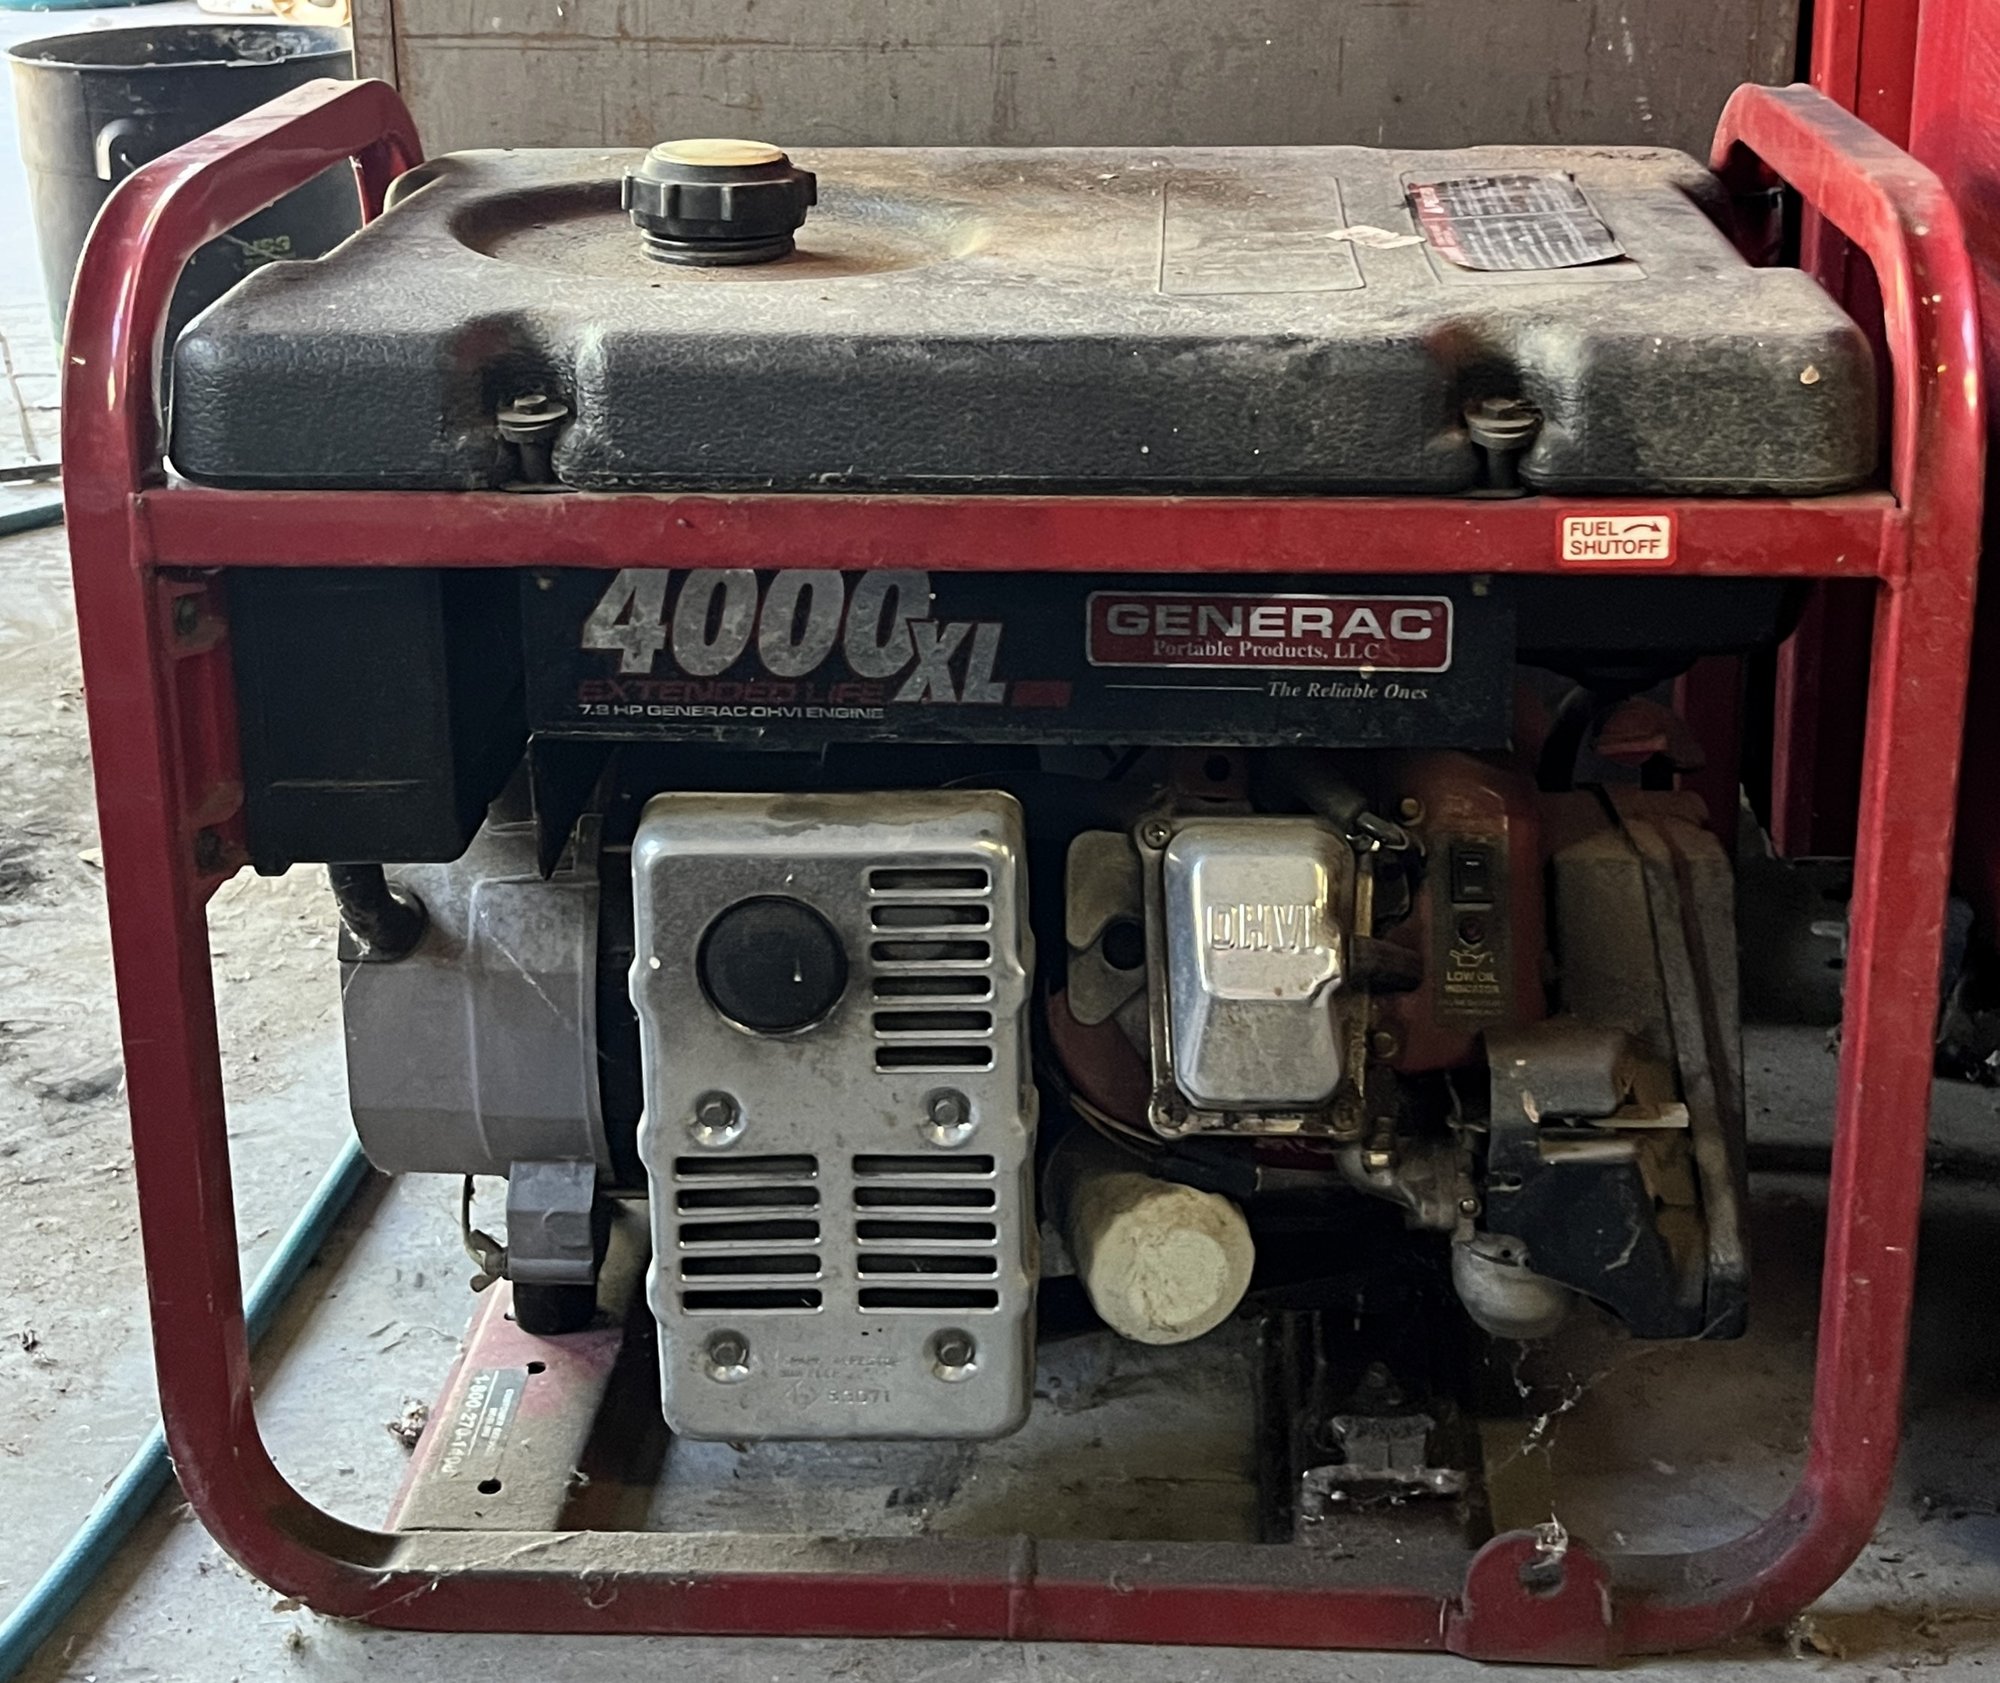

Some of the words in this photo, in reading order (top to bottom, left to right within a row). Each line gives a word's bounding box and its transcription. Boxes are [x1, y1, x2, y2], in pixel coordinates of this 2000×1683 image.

[1570, 521, 1619, 537] FUEL
[1570, 539, 1662, 555] SHUTOFF
[1106, 603, 1433, 641] GENERAC
[581, 568, 931, 678] 4000
[893, 618, 1008, 703] XL
[1153, 640, 1234, 657] Portable
[1239, 641, 1329, 660] Products,
[1334, 643, 1381, 660] LLC
[578, 680, 796, 702] EXTENDED
[1268, 681, 1301, 698] The
[1307, 682, 1379, 699] Reliable
[1384, 684, 1429, 700] Ones
[614, 704, 644, 716] HP
[647, 705, 748, 718] GENERAC
[751, 706, 802, 718] OHVI
[806, 707, 885, 719] ENGINE
[1447, 970, 1475, 982] LOW
